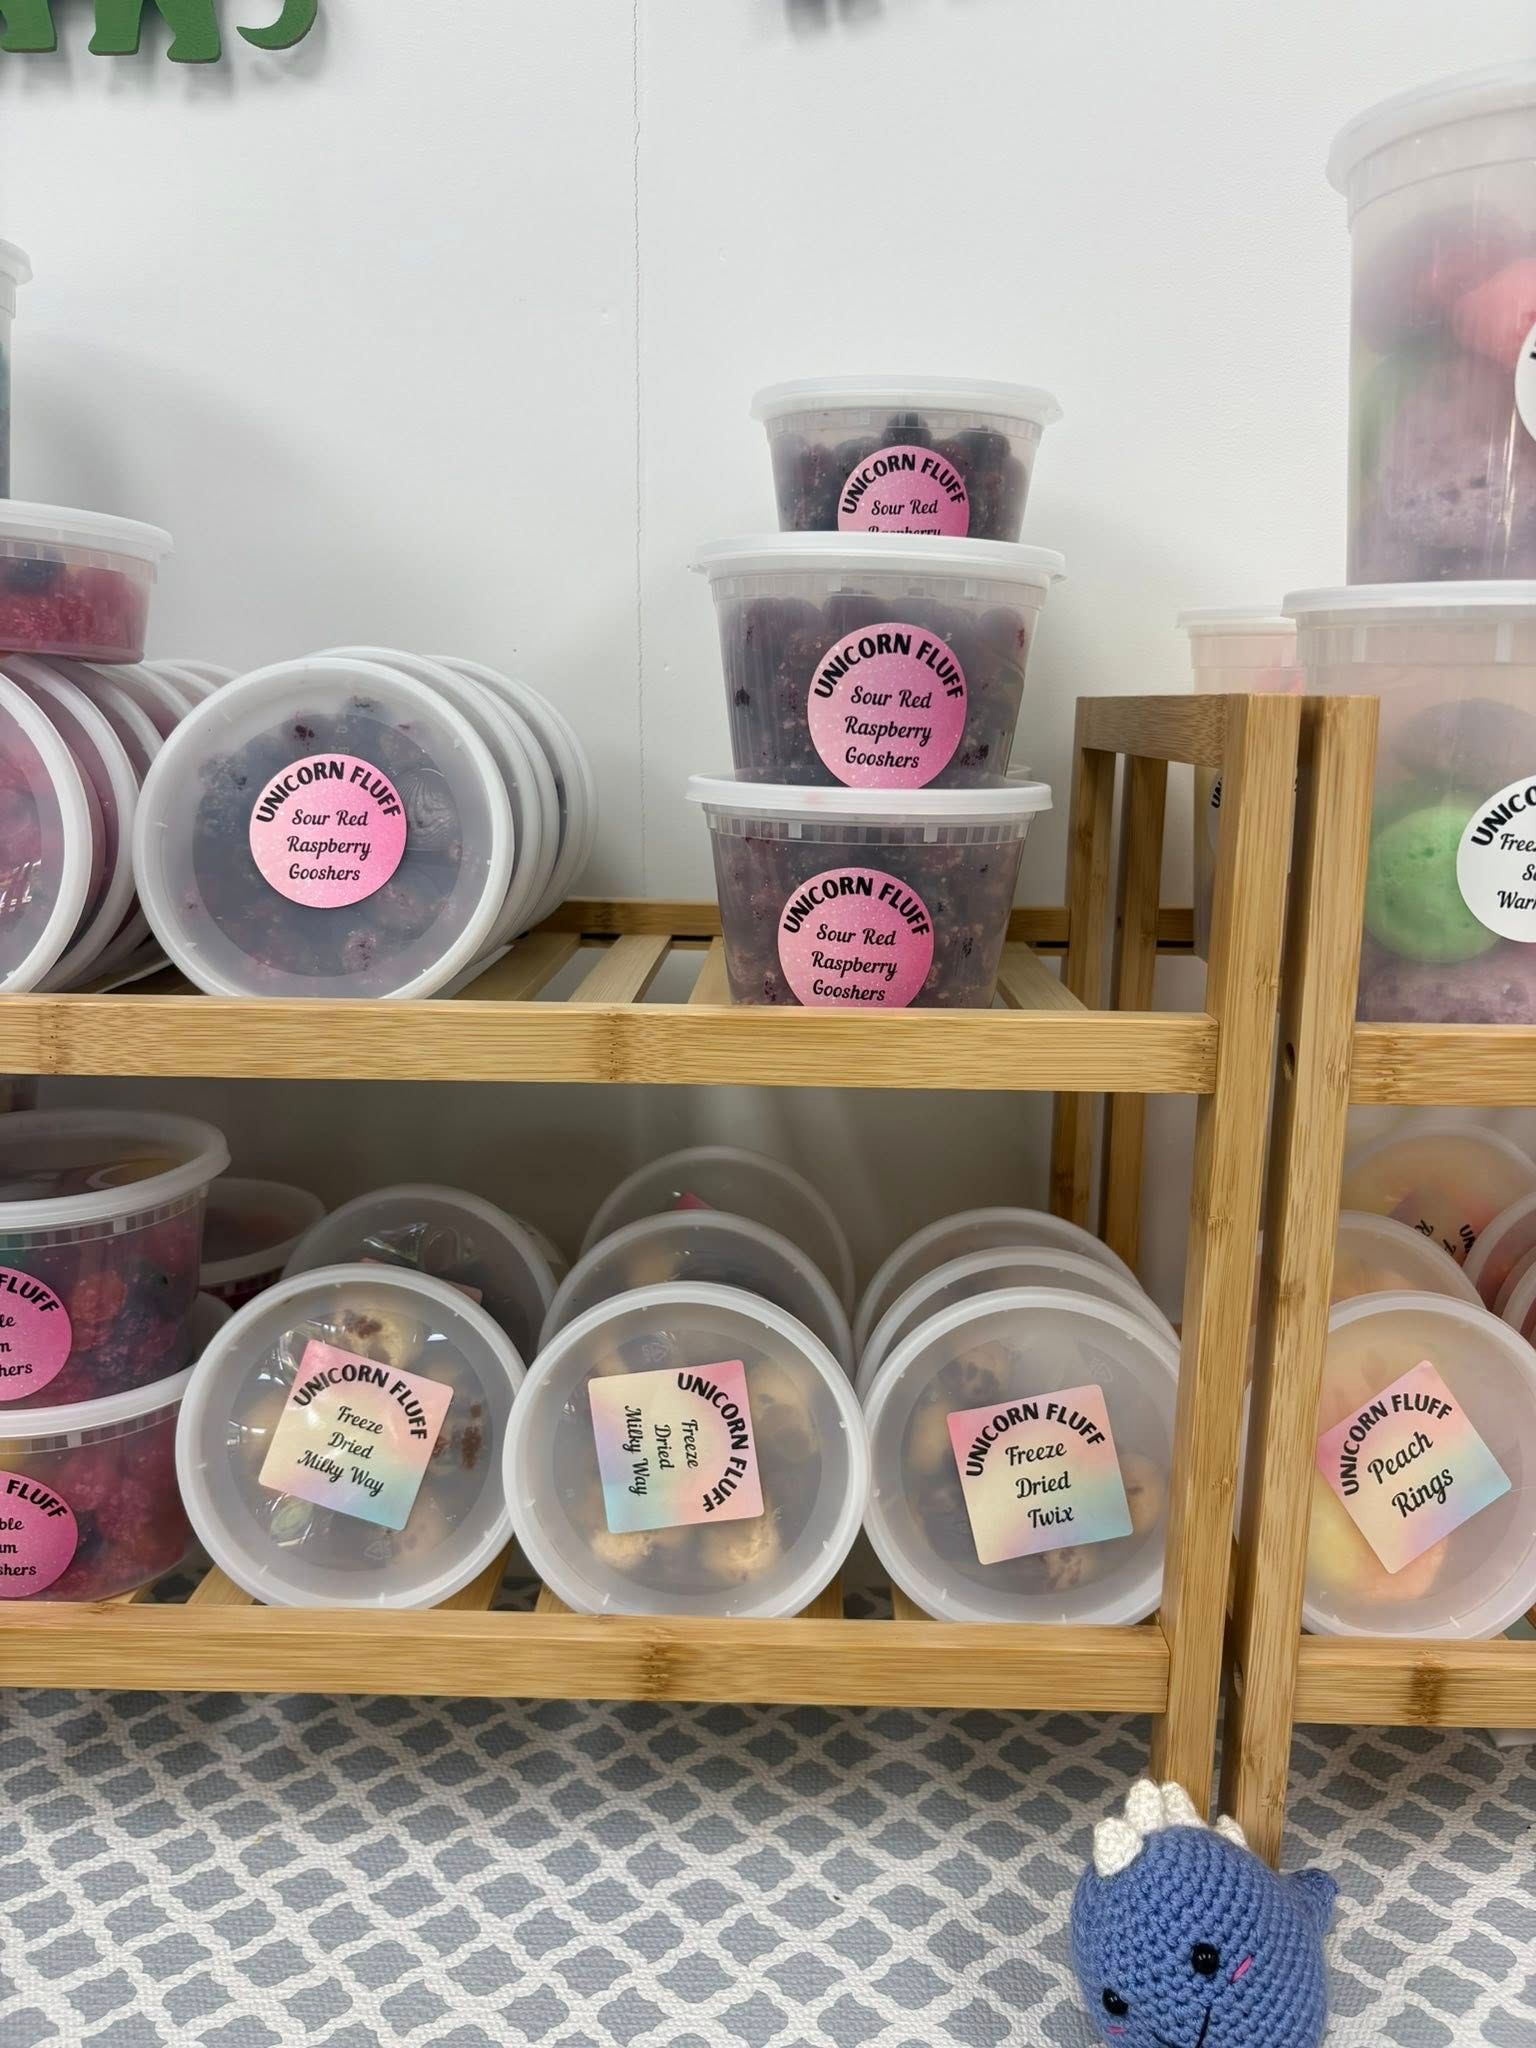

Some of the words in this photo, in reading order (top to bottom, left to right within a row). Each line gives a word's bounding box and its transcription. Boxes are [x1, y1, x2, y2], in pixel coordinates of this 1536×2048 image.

[842, 454, 915, 514] UNICORN
[921, 458, 965, 504] FLUFF
[871, 500, 905, 516] Sour
[910, 499, 938, 515] Red
[814, 633, 912, 698] UNICORN
[916, 640, 963, 699] FLUFF
[851, 686, 892, 705] Sour
[898, 689, 932, 708] Red
[844, 716, 932, 747] Raspberry
[845, 746, 920, 768] Gooshers
[256, 760, 344, 823] UNICORN
[350, 766, 401, 817] FLUFF
[292, 809, 331, 826] Sour
[336, 810, 368, 826] Red
[287, 836, 372, 861] Raspberry
[289, 863, 361, 881] Gooshers
[783, 876, 873, 933] UNICORN
[878, 883, 930, 936] FLUFF
[816, 924, 856, 943] Sour
[863, 928, 896, 946] Red
[811, 951, 897, 982] Raspberry
[813, 979, 886, 1001] Gooshers
[293, 1364, 390, 1407] UNICORN
[389, 1380, 428, 1440] FLUFF
[337, 1405, 383, 1435] Freeze
[677, 1372, 749, 1450] UNICORN
[327, 1431, 374, 1459] Dried
[622, 1405, 643, 1454] Milky
[654, 1424, 675, 1470] Dried
[681, 1419, 699, 1468] Freeze
[966, 1402, 1039, 1476] UNICORN
[1046, 1403, 1106, 1445] FLUFF
[1340, 1400, 1388, 1496] UNICORN
[1391, 1393, 1452, 1420] FLUFF
[1005, 1442, 1067, 1466] Freeze
[1368, 1431, 1434, 1485] Peach
[297, 1450, 344, 1483] Milky
[350, 1466, 384, 1497] Way
[628, 1457, 650, 1496] Way
[702, 1456, 748, 1512] FLUFF
[1015, 1471, 1071, 1499] Dried
[6, 1479, 68, 1517] FLUFF
[1391, 1469, 1453, 1518] Rings
[1027, 1506, 1074, 1528] Twix
